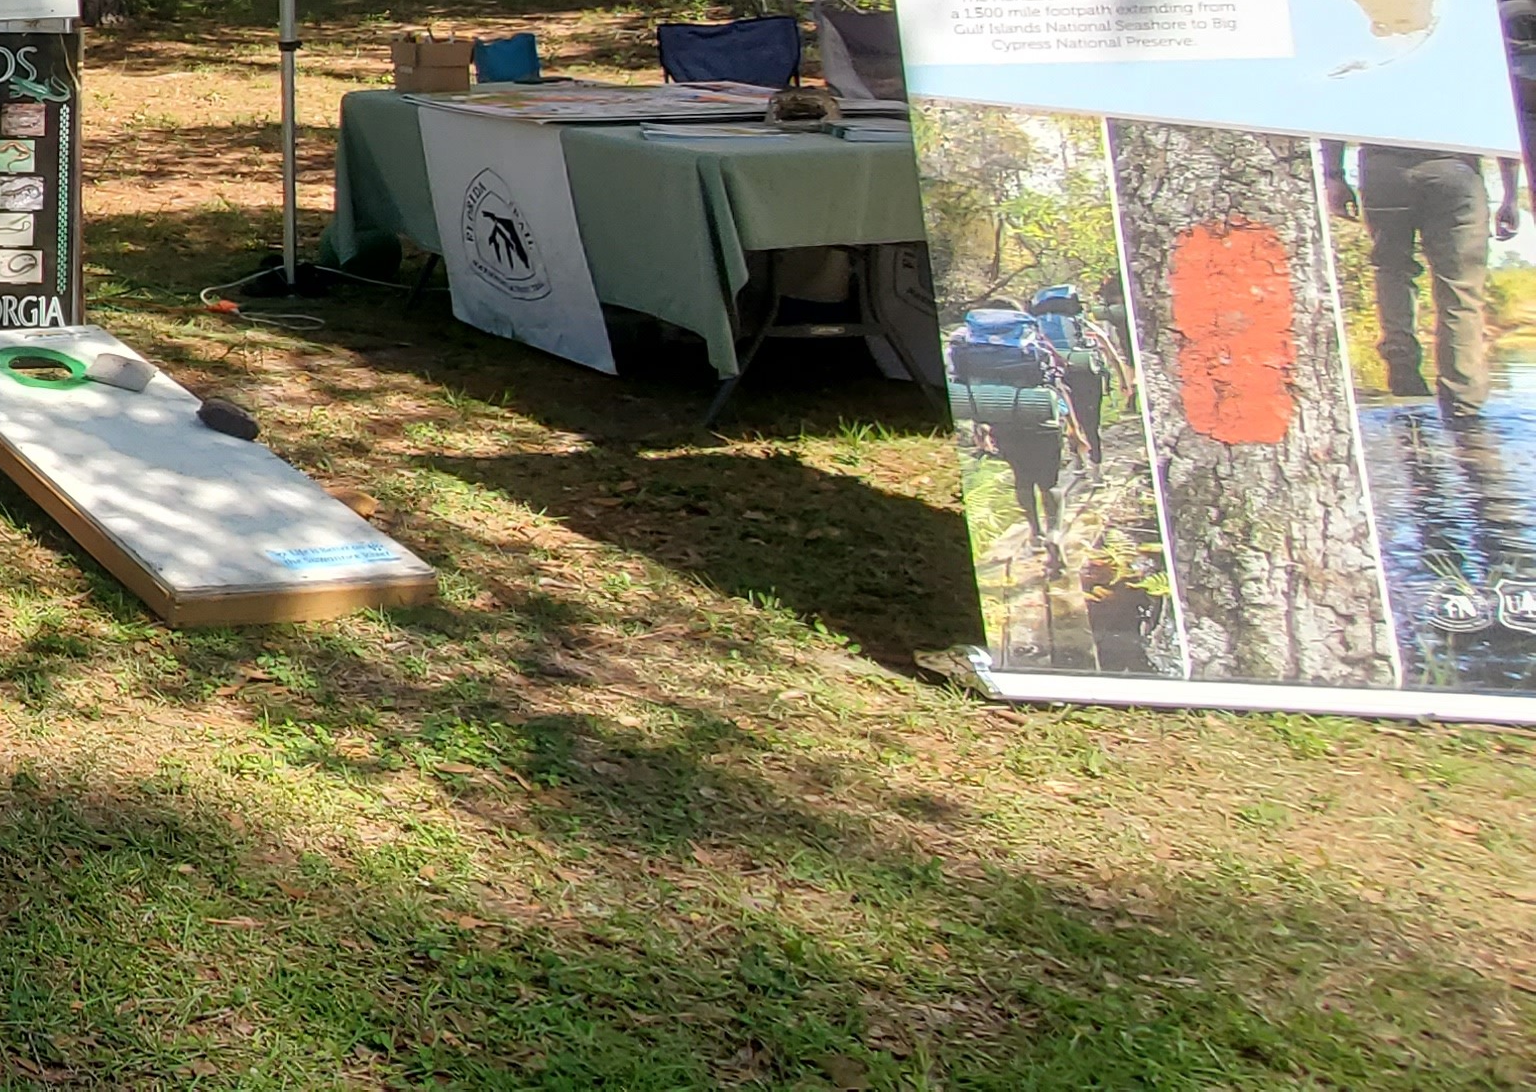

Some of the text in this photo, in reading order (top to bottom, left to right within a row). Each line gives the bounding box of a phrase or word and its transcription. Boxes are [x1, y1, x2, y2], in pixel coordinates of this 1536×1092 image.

[950, 10, 960, 20] a
[1007, 5, 1041, 18] mile
[1045, 3, 1111, 21] footpath
[1116, 2, 1194, 19] extending
[1198, 0, 1236, 13] from
[953, 16, 1238, 36] Gulf Islands National Seashore to Big
[991, 38, 1052, 54] Cypress
[1056, 35, 1122, 49] National
